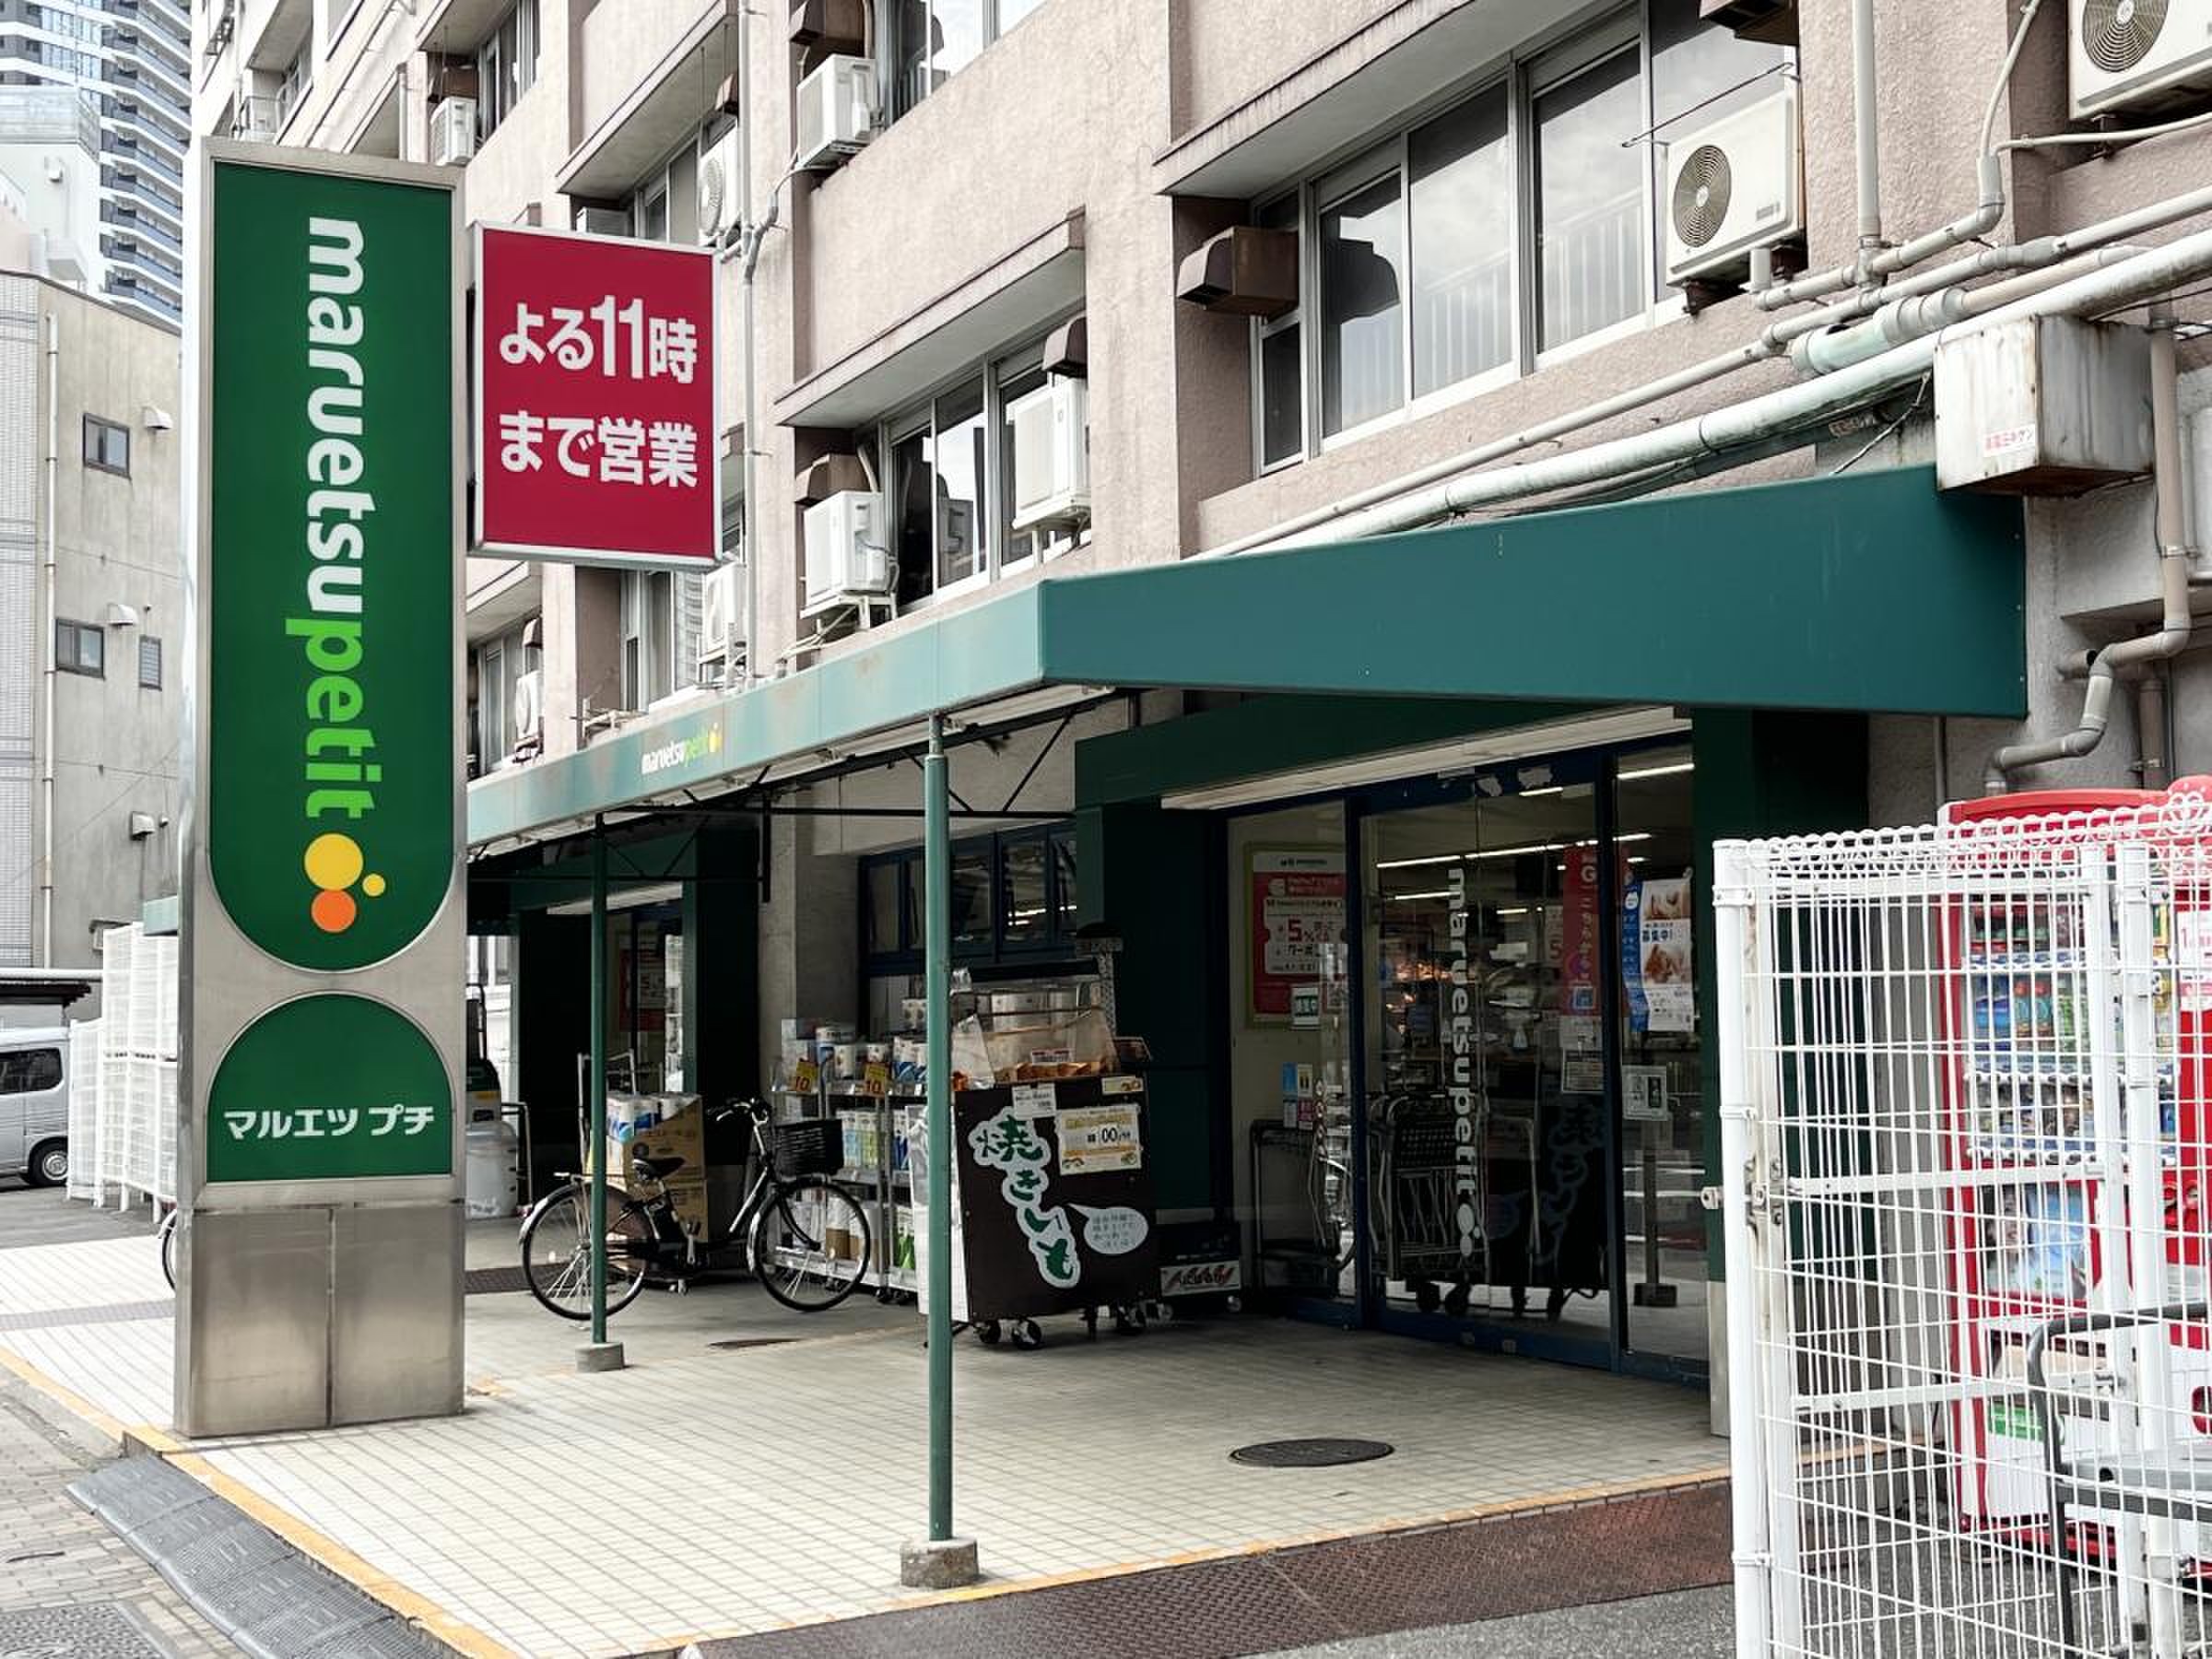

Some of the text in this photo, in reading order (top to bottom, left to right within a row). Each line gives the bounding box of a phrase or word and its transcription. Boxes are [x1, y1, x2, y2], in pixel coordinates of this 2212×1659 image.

[499, 294, 699, 384] よる11時
[499, 410, 699, 488] まで営業
[286, 217, 382, 818] maruetsupetit
[223, 1103, 435, 1140] マルエツ プチ
[975, 1115, 1075, 1282] 焼きいも
